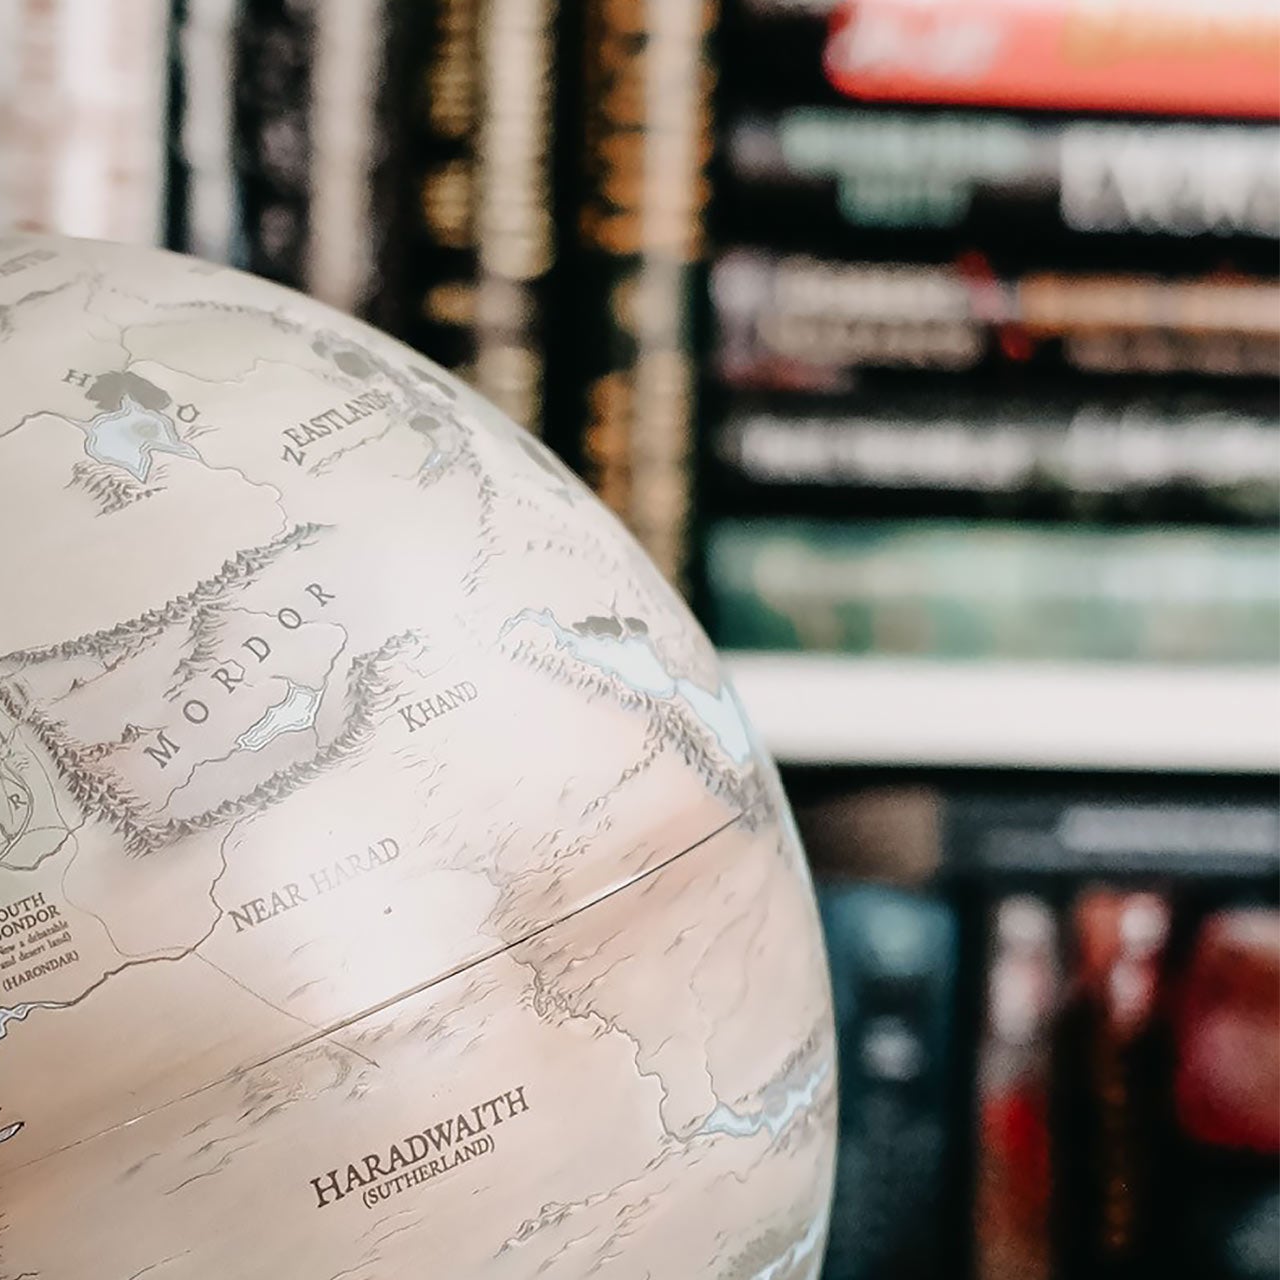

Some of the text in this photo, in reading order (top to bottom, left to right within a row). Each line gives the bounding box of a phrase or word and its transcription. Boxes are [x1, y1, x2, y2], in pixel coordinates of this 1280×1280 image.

[144, 582, 336, 769] MORDOR
[397, 681, 477, 733] KHAND
[228, 837, 400, 933] NEAR HARAD
[2, 949, 80, 992] (HARONDAR)
[309, 1085, 530, 1208] HARADWAITH
[362, 1133, 496, 1209] (SUTHERLAND)
